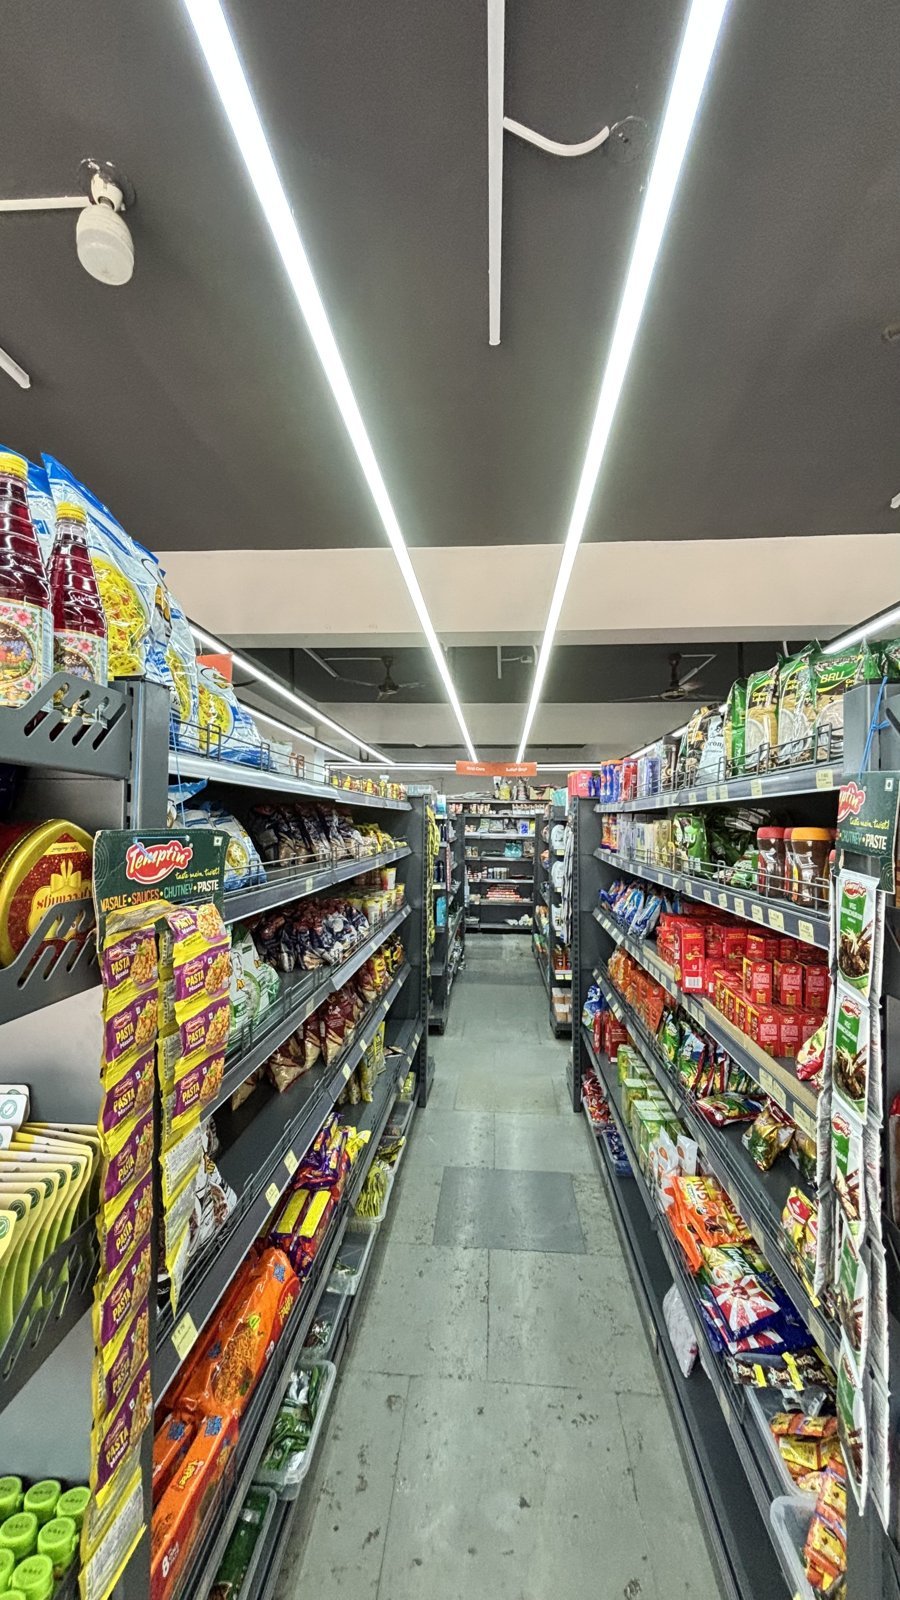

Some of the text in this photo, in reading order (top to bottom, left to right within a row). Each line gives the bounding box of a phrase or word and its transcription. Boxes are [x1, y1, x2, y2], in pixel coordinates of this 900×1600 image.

[820, 672, 846, 684] BRU
[865, 834, 887, 849] PASTE
[129, 845, 183, 874] Temptin
[164, 883, 193, 899] CHUTNEY
[197, 879, 220, 893] PASTE
[185, 970, 204, 988] PASTA
[116, 1022, 134, 1045] PASTA
[113, 1088, 135, 1113] PASTA
[182, 1081, 200, 1103] PASTA
[113, 1288, 131, 1321] PASTA
[106, 1426, 129, 1464] PASTA
